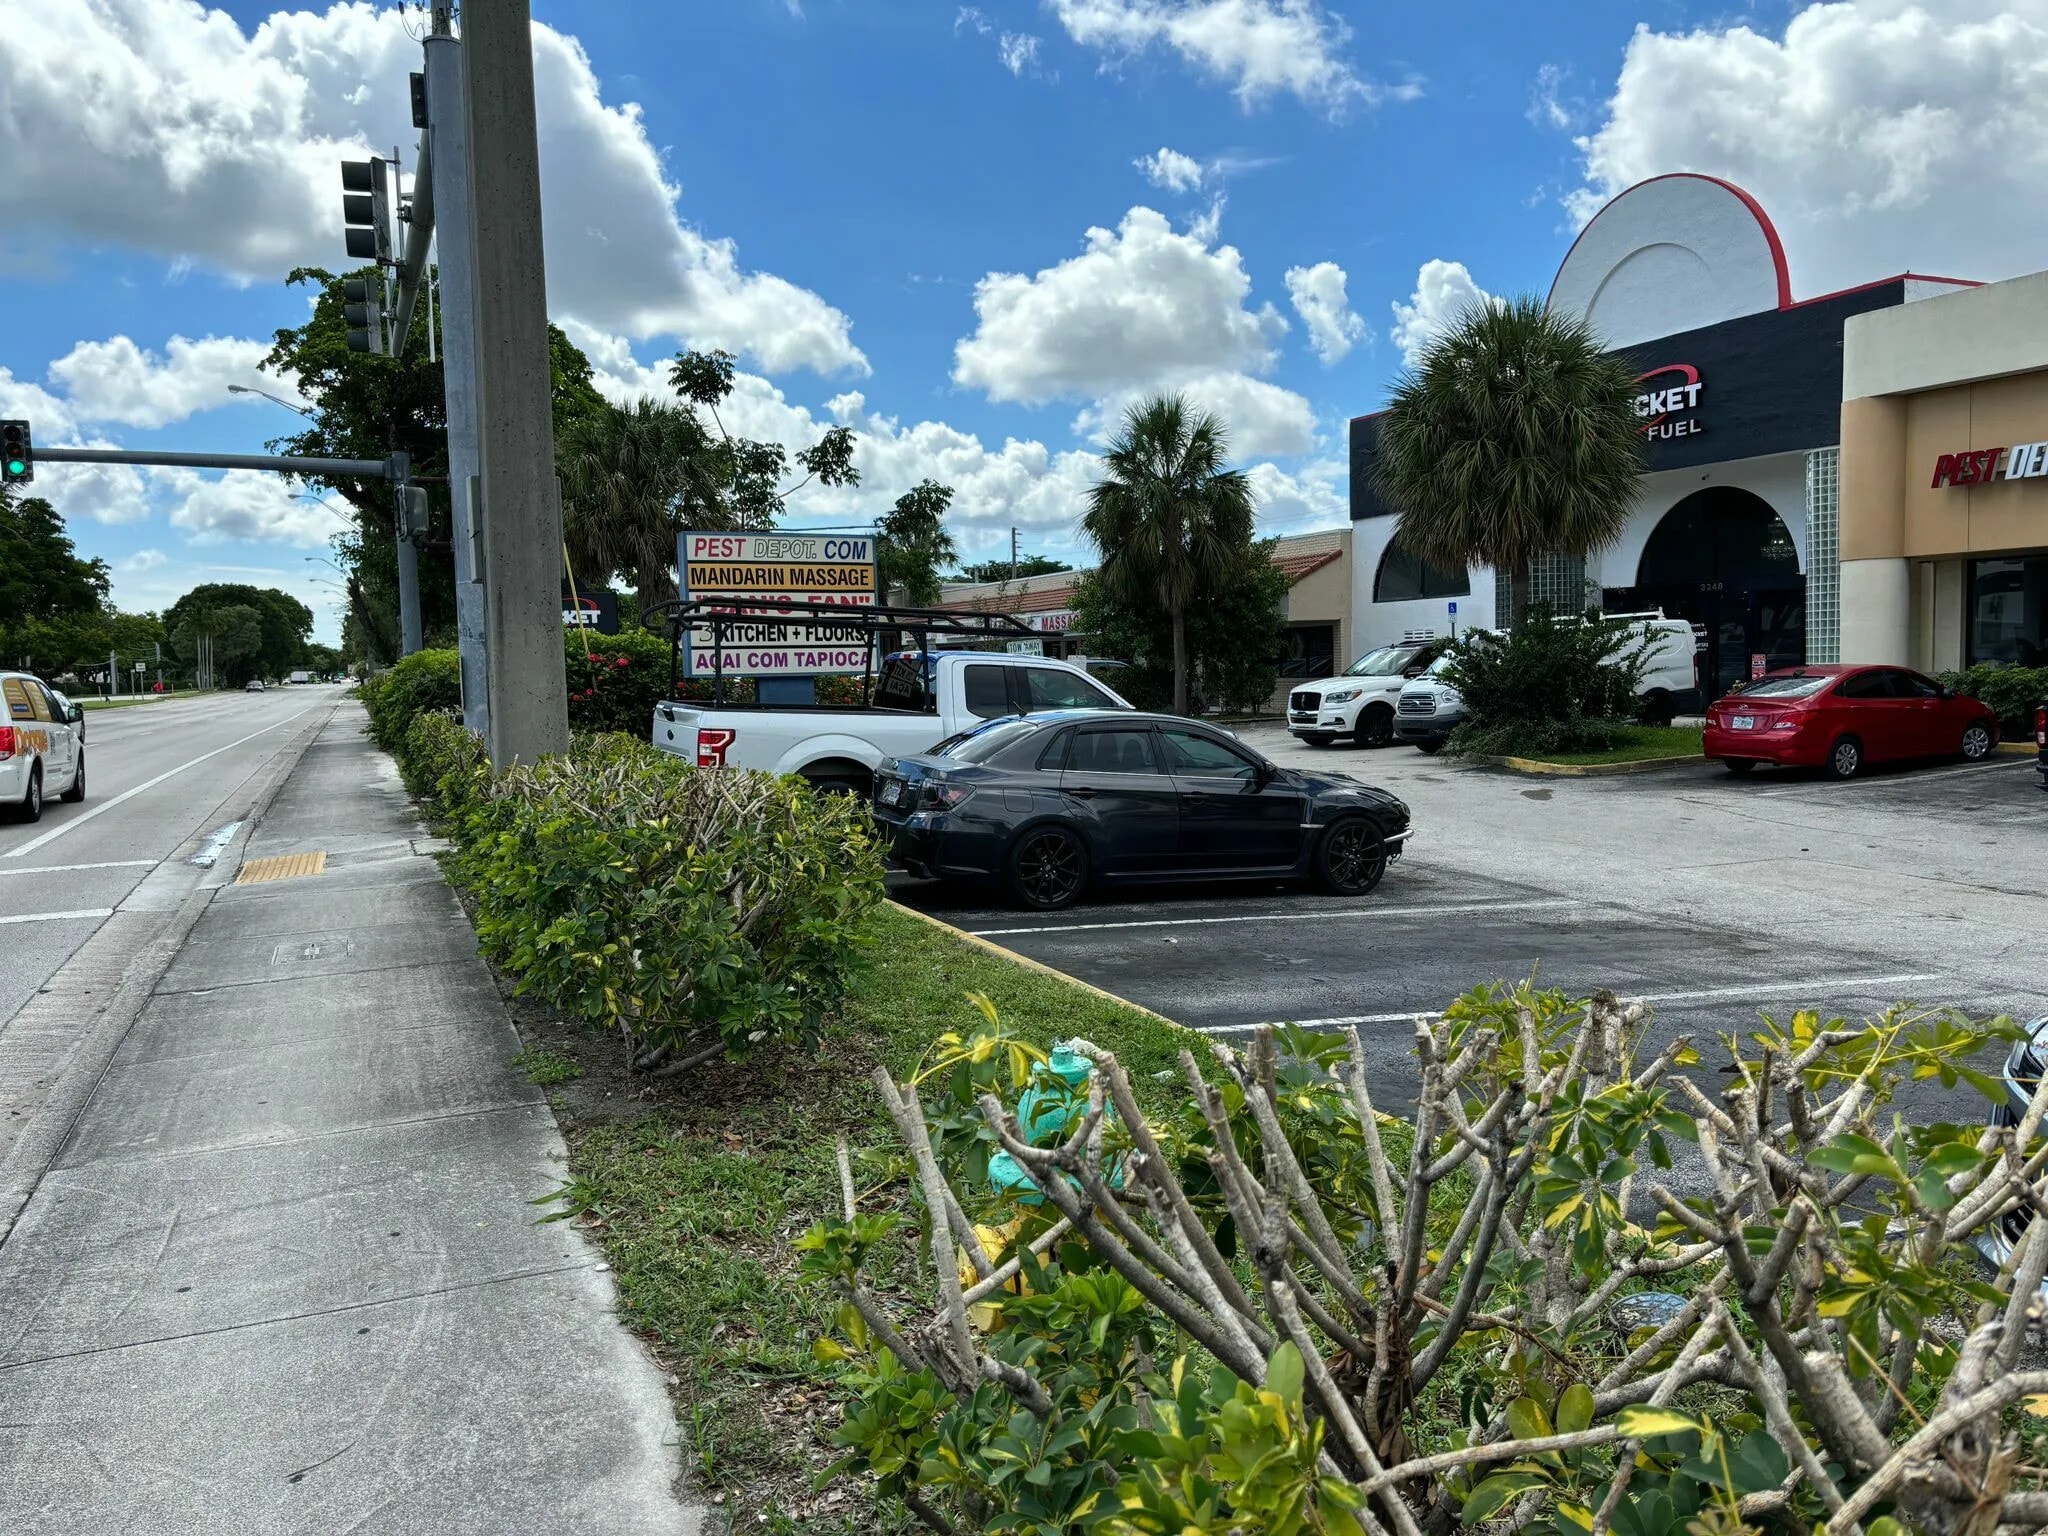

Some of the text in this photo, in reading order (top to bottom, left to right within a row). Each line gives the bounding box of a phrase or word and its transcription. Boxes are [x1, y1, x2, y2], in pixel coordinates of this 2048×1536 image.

[1628, 382, 1702, 417] CKET
[1648, 419, 1702, 441] FUEL
[1931, 441, 2048, 488] PEST DE
[694, 538, 746, 557] PEST
[824, 540, 867, 560] COM
[691, 567, 869, 586] MANDARIN MASSAGE
[720, 624, 788, 642] KITCHEN
[806, 624, 866, 642] FLOORS
[747, 652, 788, 667] COM
[794, 651, 868, 667] TAPIOCA
